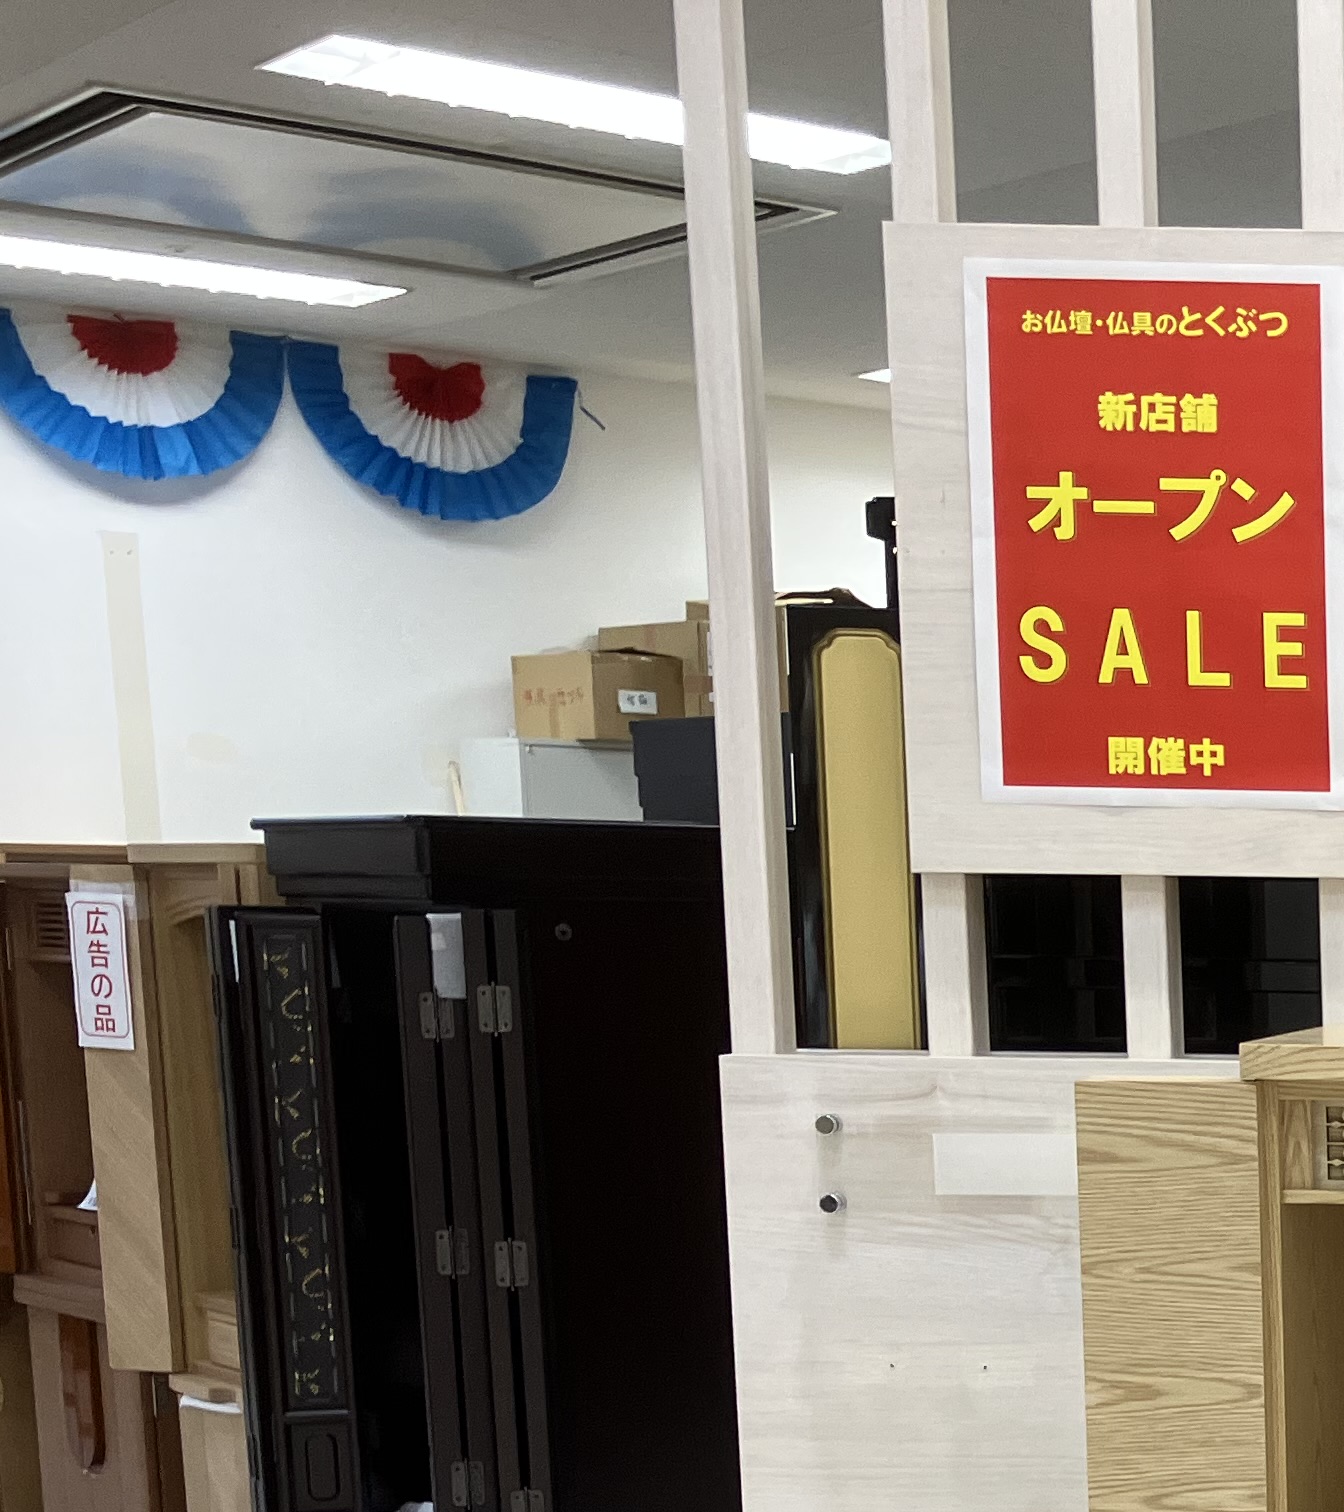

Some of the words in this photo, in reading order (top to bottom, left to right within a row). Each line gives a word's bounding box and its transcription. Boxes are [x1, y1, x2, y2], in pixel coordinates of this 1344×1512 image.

[1021, 306, 1290, 337] お仏壇・仏具のとくぶつ
[1098, 392, 1219, 433] 新店舗
[1026, 469, 1296, 542] オープン
[1019, 605, 1310, 689] SALE
[1107, 736, 1226, 777] 開催中
[86, 907, 116, 1033] 広告の品
